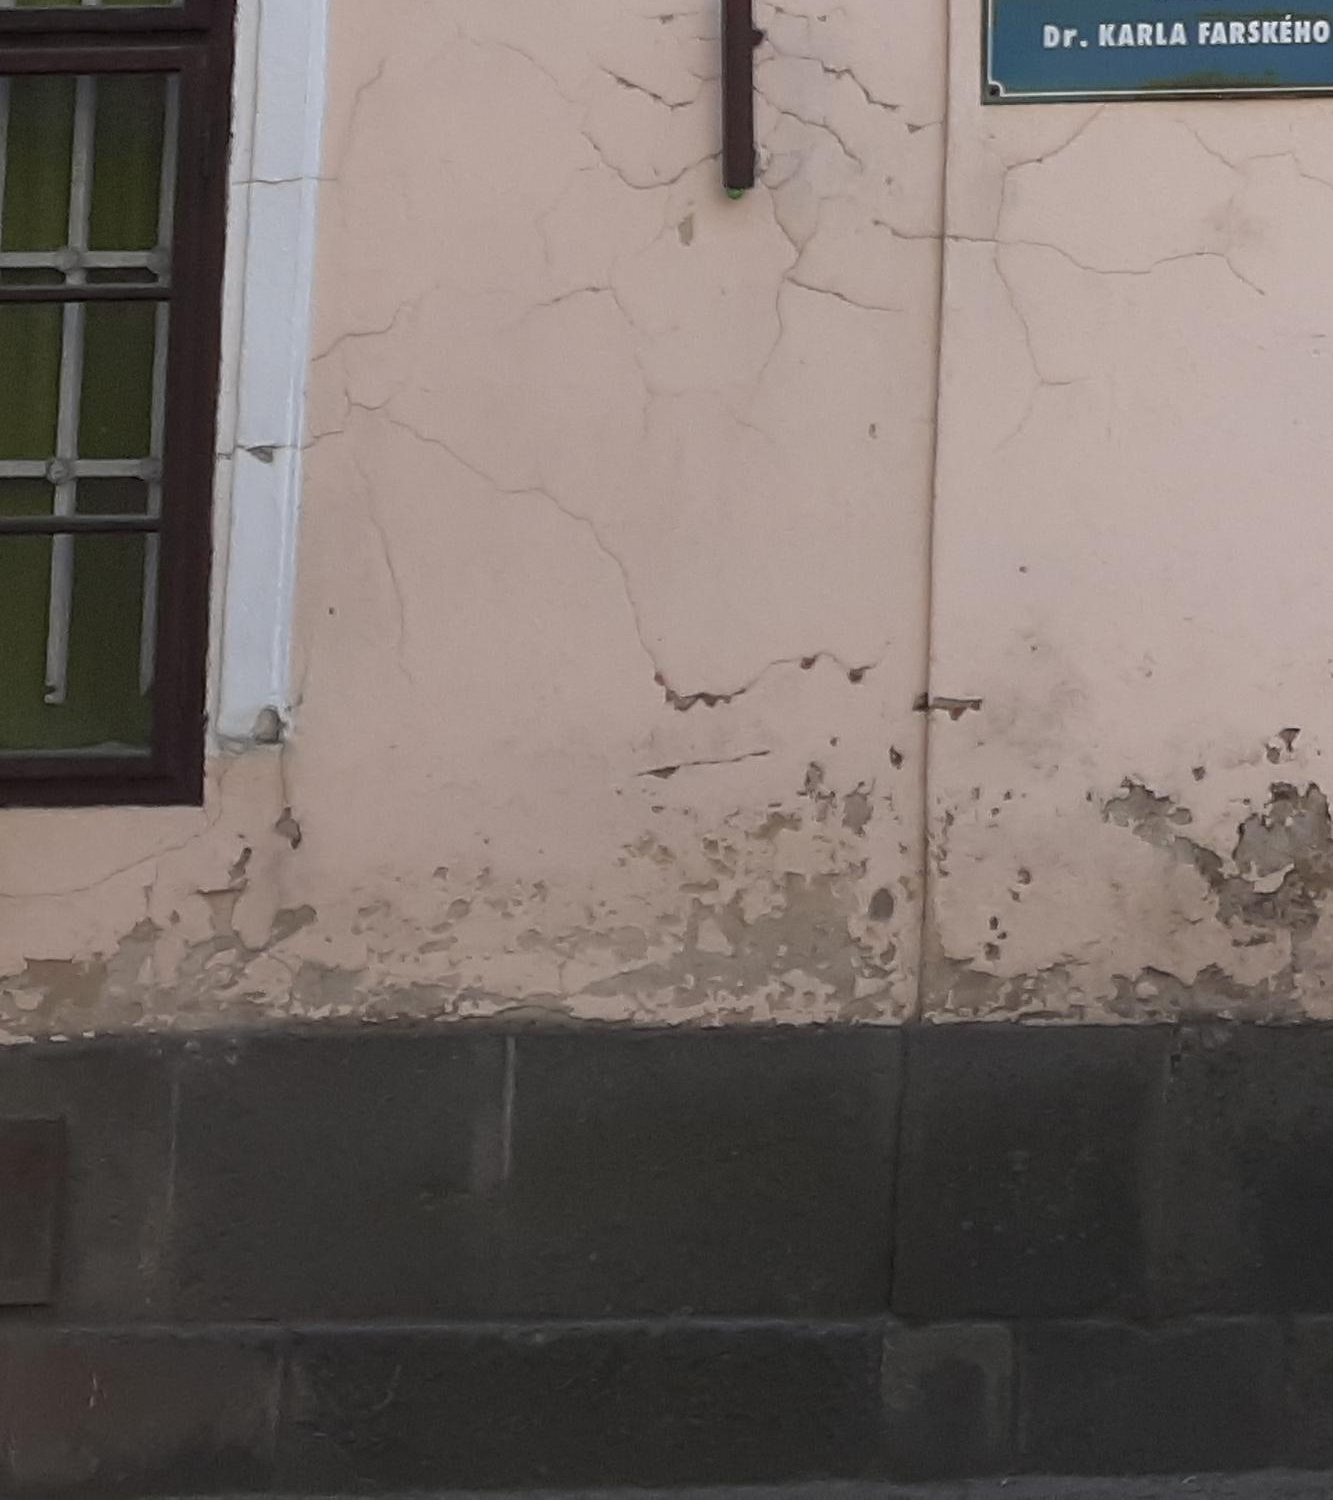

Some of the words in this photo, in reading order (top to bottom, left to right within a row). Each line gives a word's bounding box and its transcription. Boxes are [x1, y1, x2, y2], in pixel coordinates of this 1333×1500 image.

[1042, 24, 1089, 49] Dr.
[1099, 22, 1189, 47] KARLA
[1198, 14, 1331, 44] FARSKÉHO
